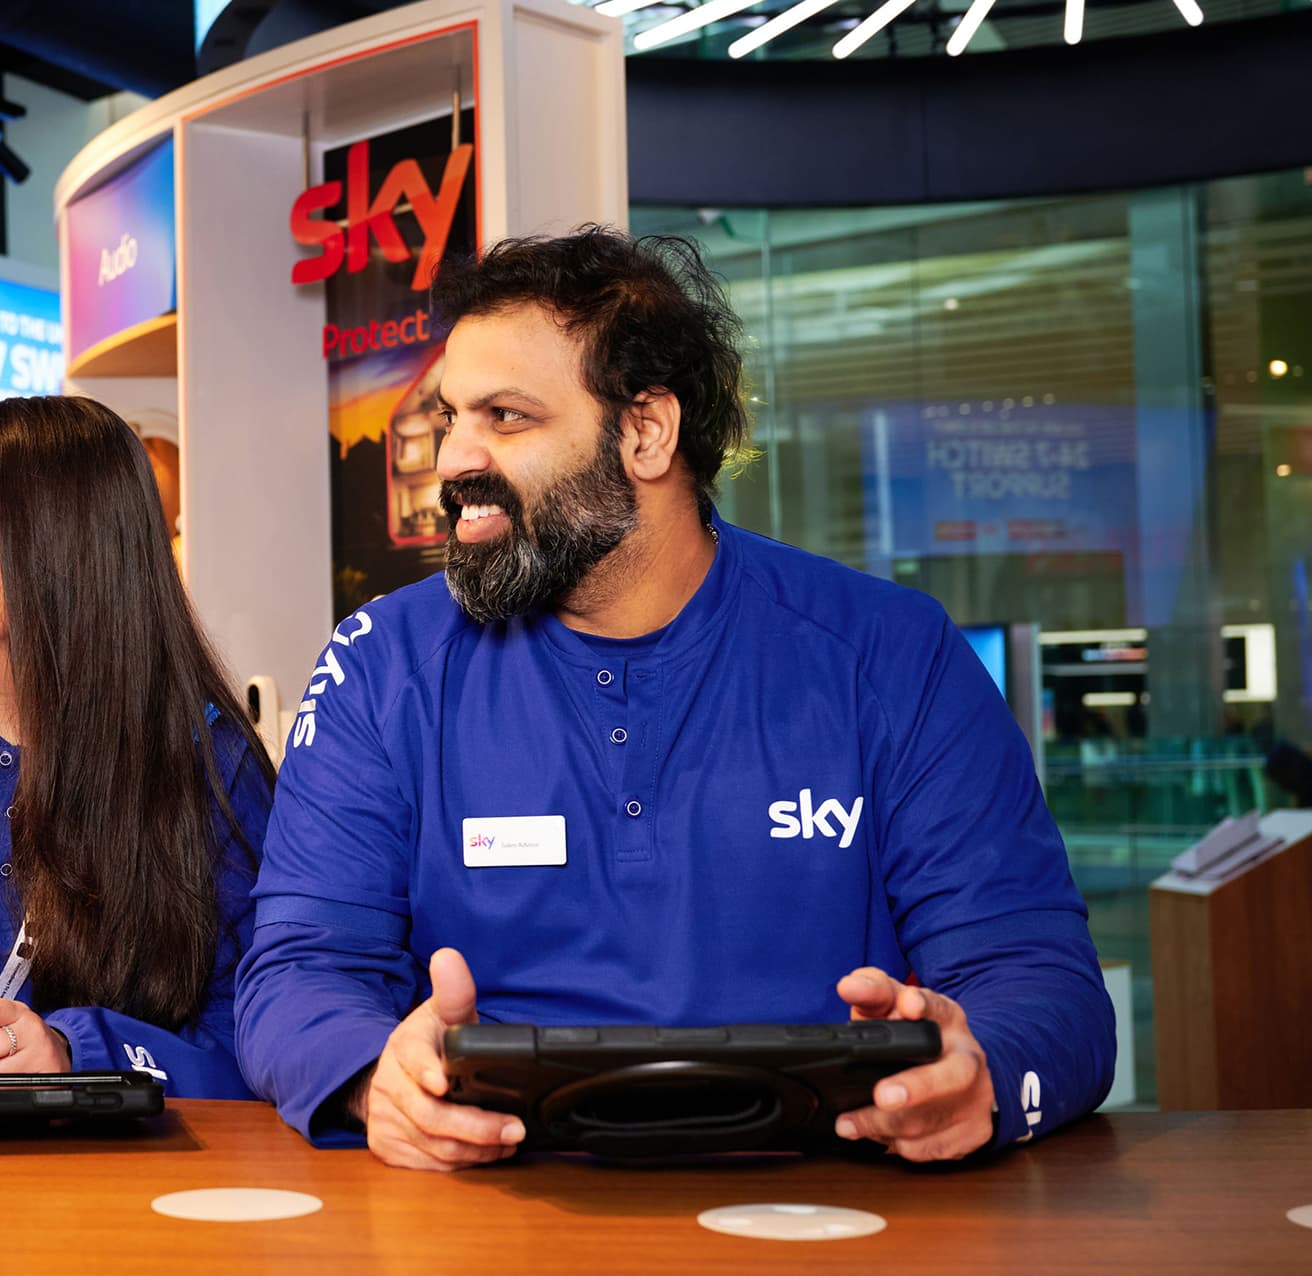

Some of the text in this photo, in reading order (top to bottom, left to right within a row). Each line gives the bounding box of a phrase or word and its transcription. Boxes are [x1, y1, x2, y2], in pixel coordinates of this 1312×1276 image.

[290, 140, 473, 291] sky
[98, 232, 139, 288] Audio
[322, 309, 430, 359] Protect
[470, 833, 496, 850] sky
[768, 788, 864, 848] sky
